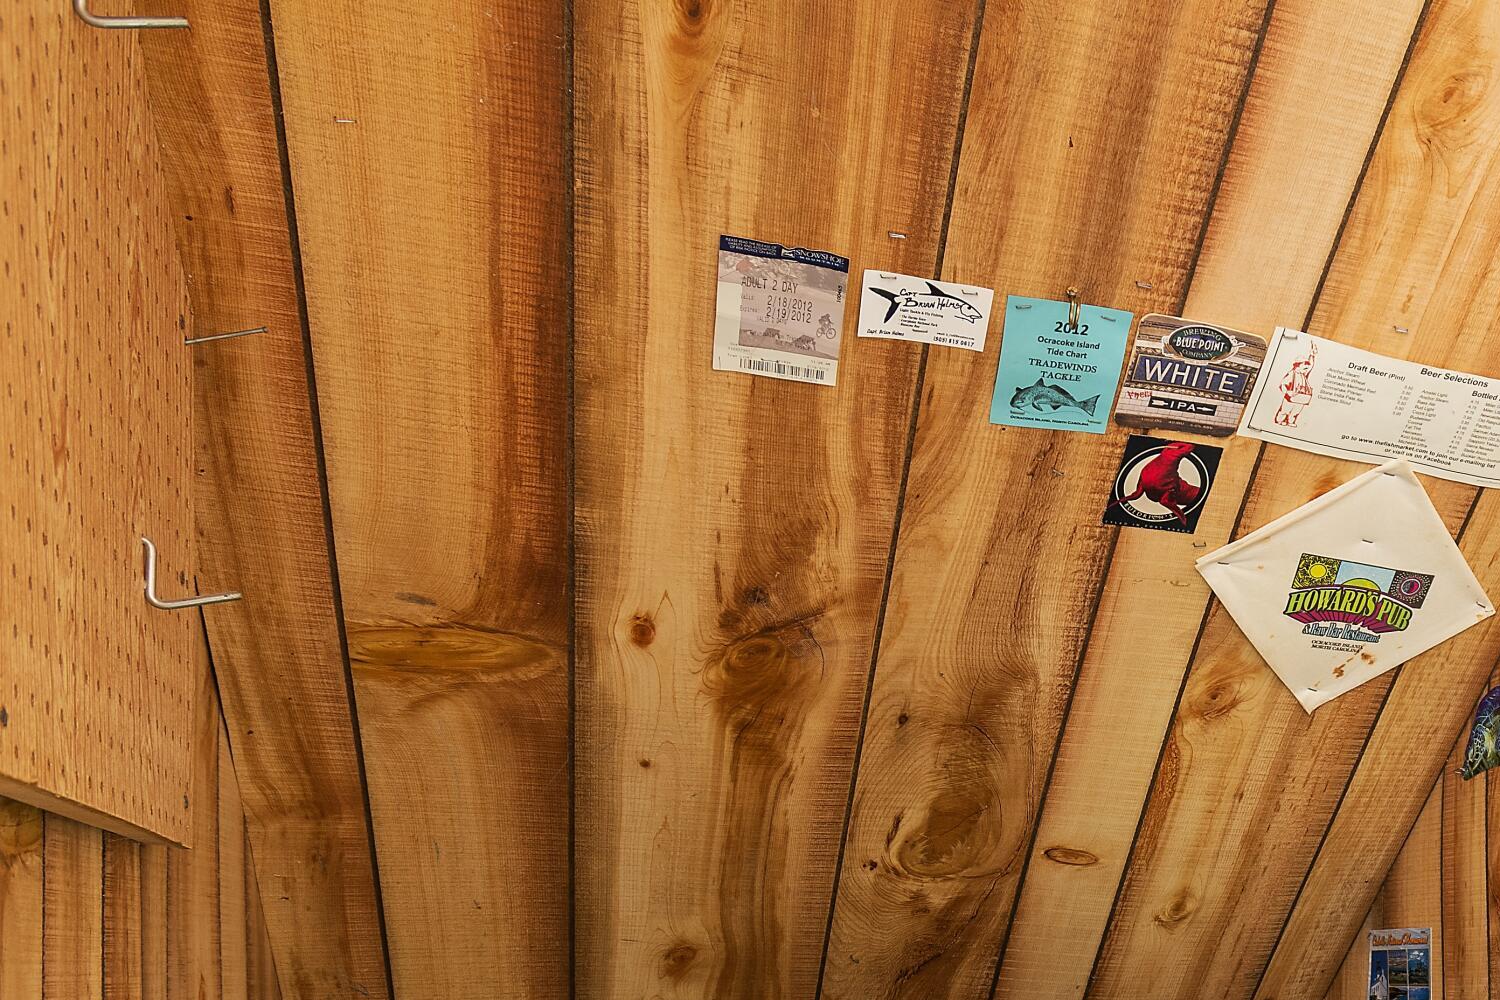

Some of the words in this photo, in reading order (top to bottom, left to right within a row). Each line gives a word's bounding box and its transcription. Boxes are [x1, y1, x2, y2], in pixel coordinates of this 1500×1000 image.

[741, 277, 767, 289] ADULT
[772, 281, 777, 290] 2
[782, 282, 798, 293] DAY
[768, 296, 813, 312] 2/18/2012
[767, 307, 811, 323] 2/19/2012
[1055, 321, 1089, 335] 2012
[1038, 336, 1075, 347] Ocracoke
[1076, 339, 1100, 350] Island
[1176, 337, 1197, 348] BLUE
[1199, 339, 1225, 352] POINT
[1047, 348, 1063, 357] Tide
[1066, 349, 1087, 358] Chart
[1029, 358, 1097, 373] TRADEWINDS
[1041, 371, 1081, 381] TACKLE
[1144, 359, 1238, 394] WHITE
[1420, 367, 1442, 380] Beer
[1443, 372, 1488, 387] Selections
[1170, 402, 1196, 412] IPA
[1286, 588, 1379, 618] HOWARD'S
[1379, 600, 1413, 630] PUB
